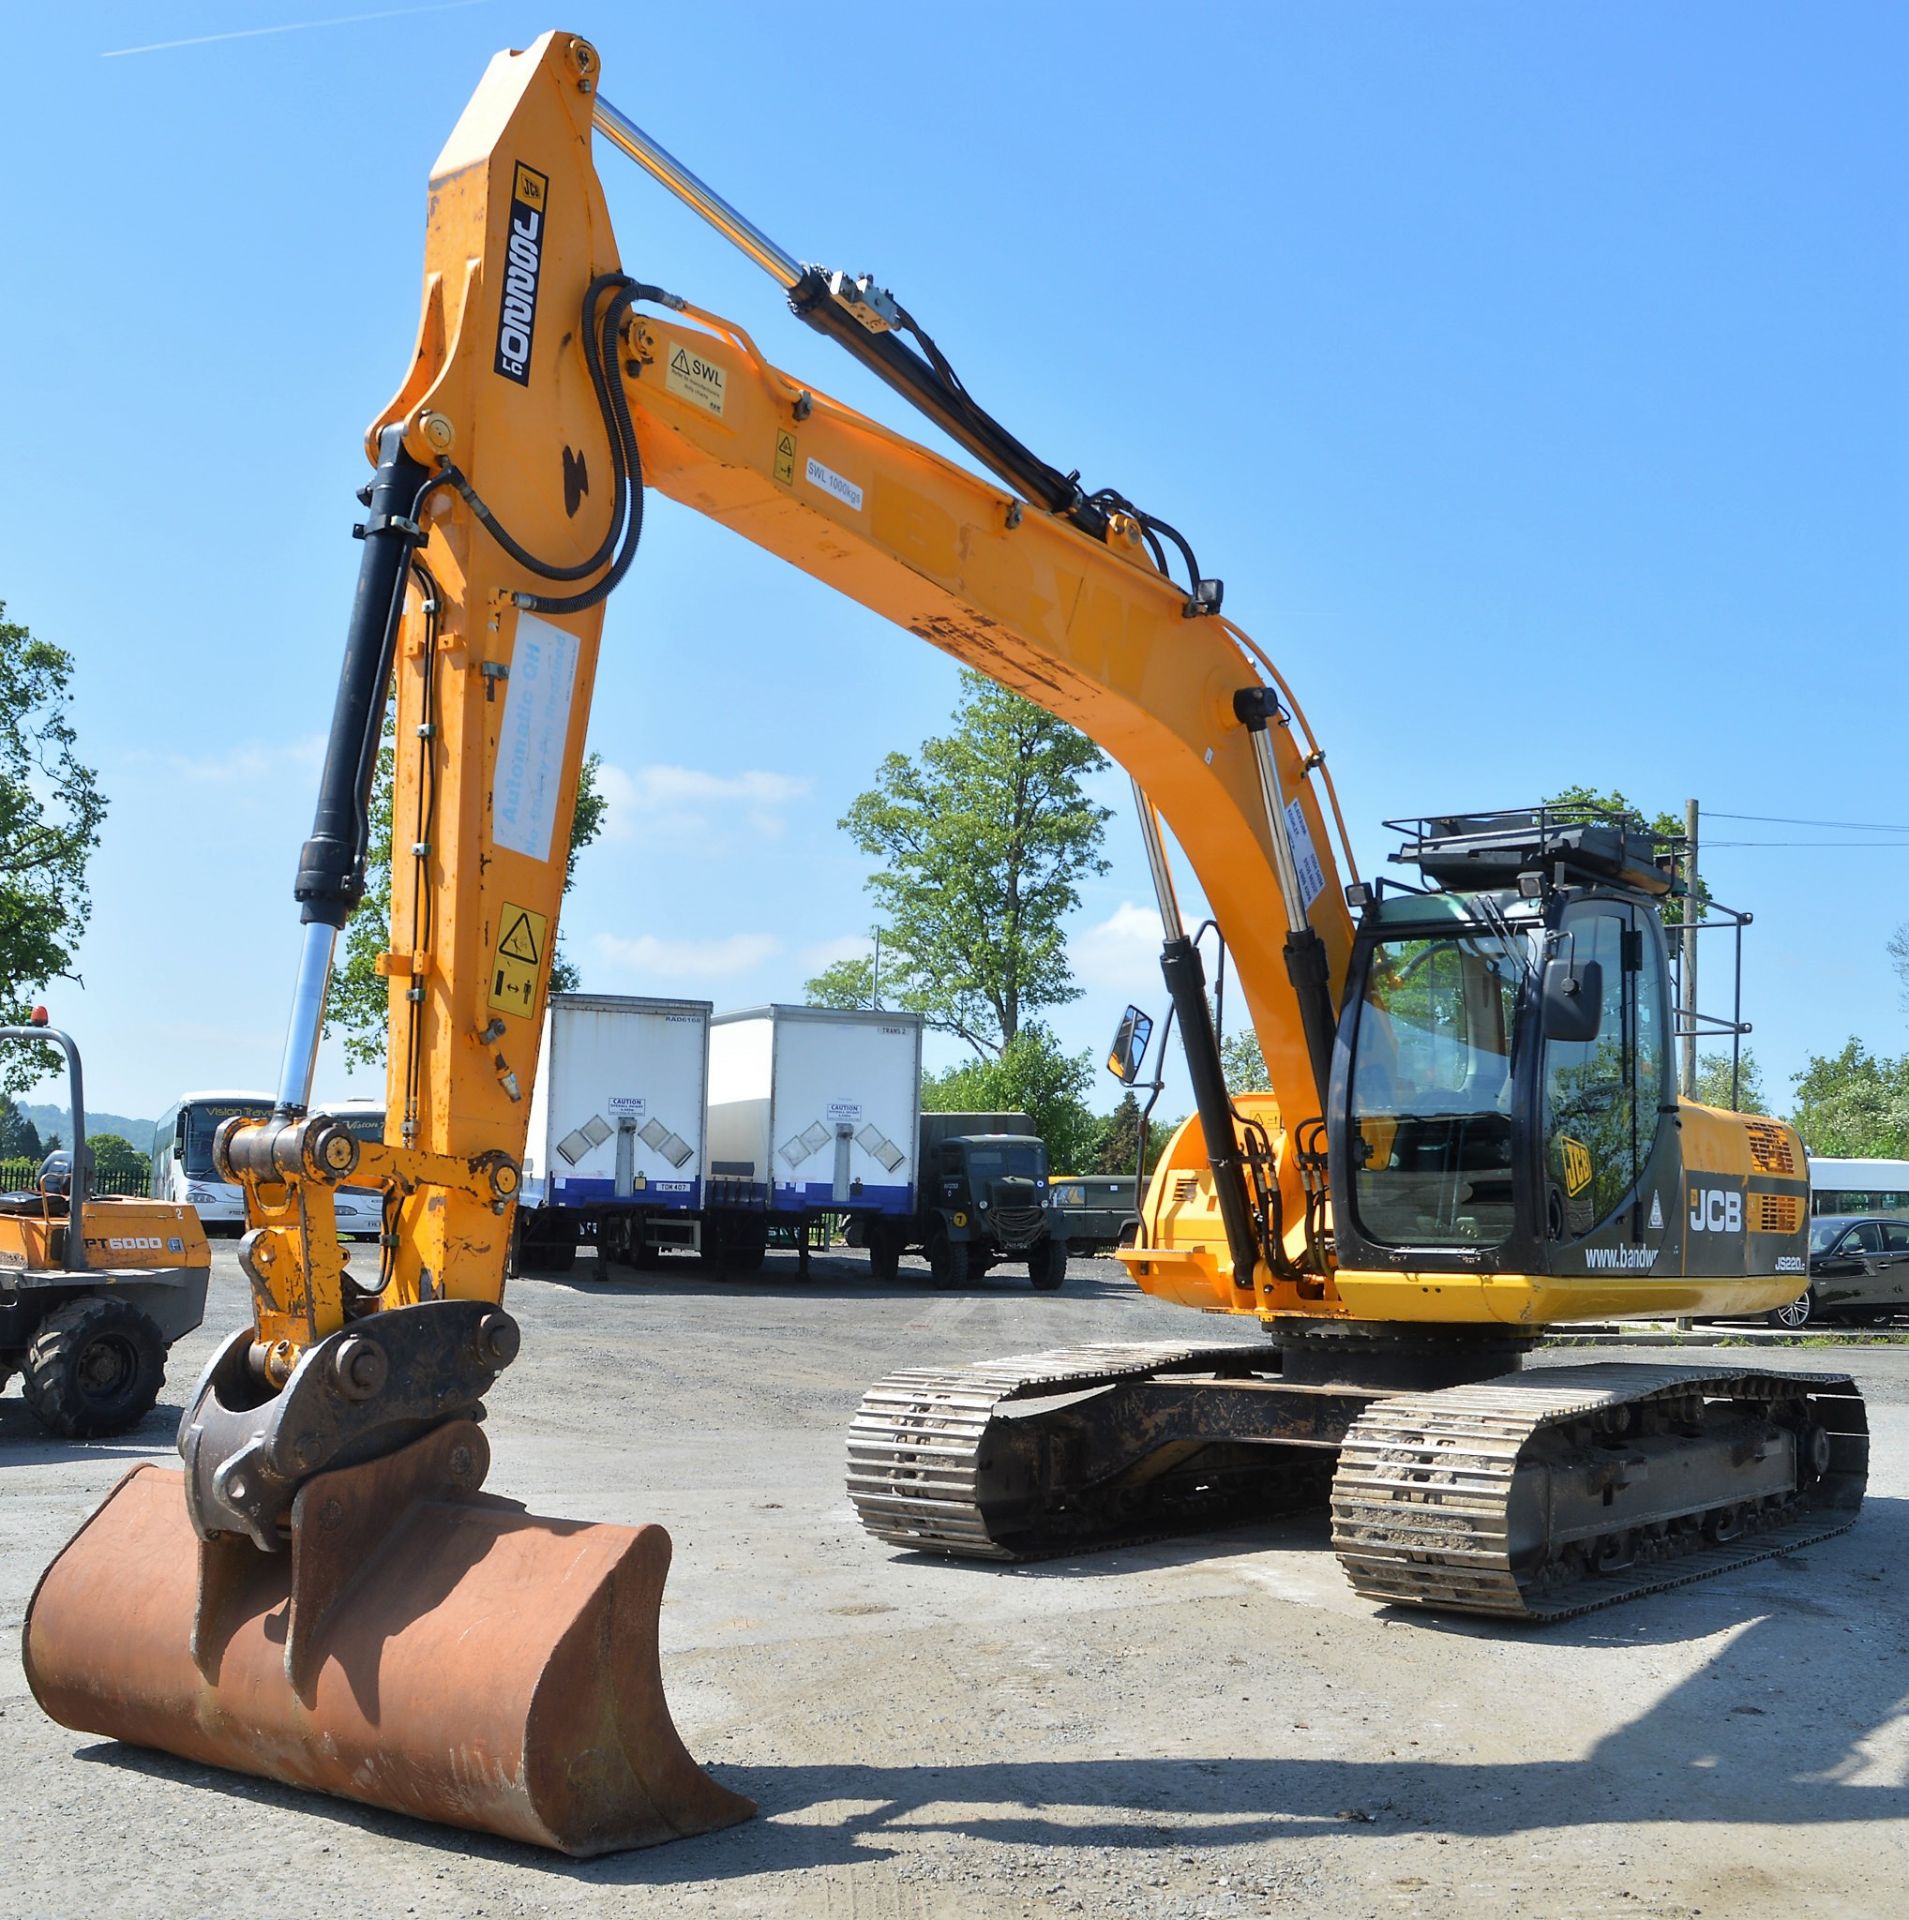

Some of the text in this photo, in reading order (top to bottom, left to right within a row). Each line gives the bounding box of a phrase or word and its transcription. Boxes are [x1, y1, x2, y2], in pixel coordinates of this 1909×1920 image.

[692, 359, 722, 388] SWL
[808, 462, 861, 505] SWL 1000kgs
[502, 641, 541, 824] Automatic QH
[205, 1106, 242, 1117] Vision
[342, 1120, 378, 1130] Vision
[1566, 1142, 1590, 1190] JCB
[175, 1207, 184, 1220] 2
[1690, 1189, 1742, 1232] JCB
[1585, 1242, 1659, 1268] www.bandw
